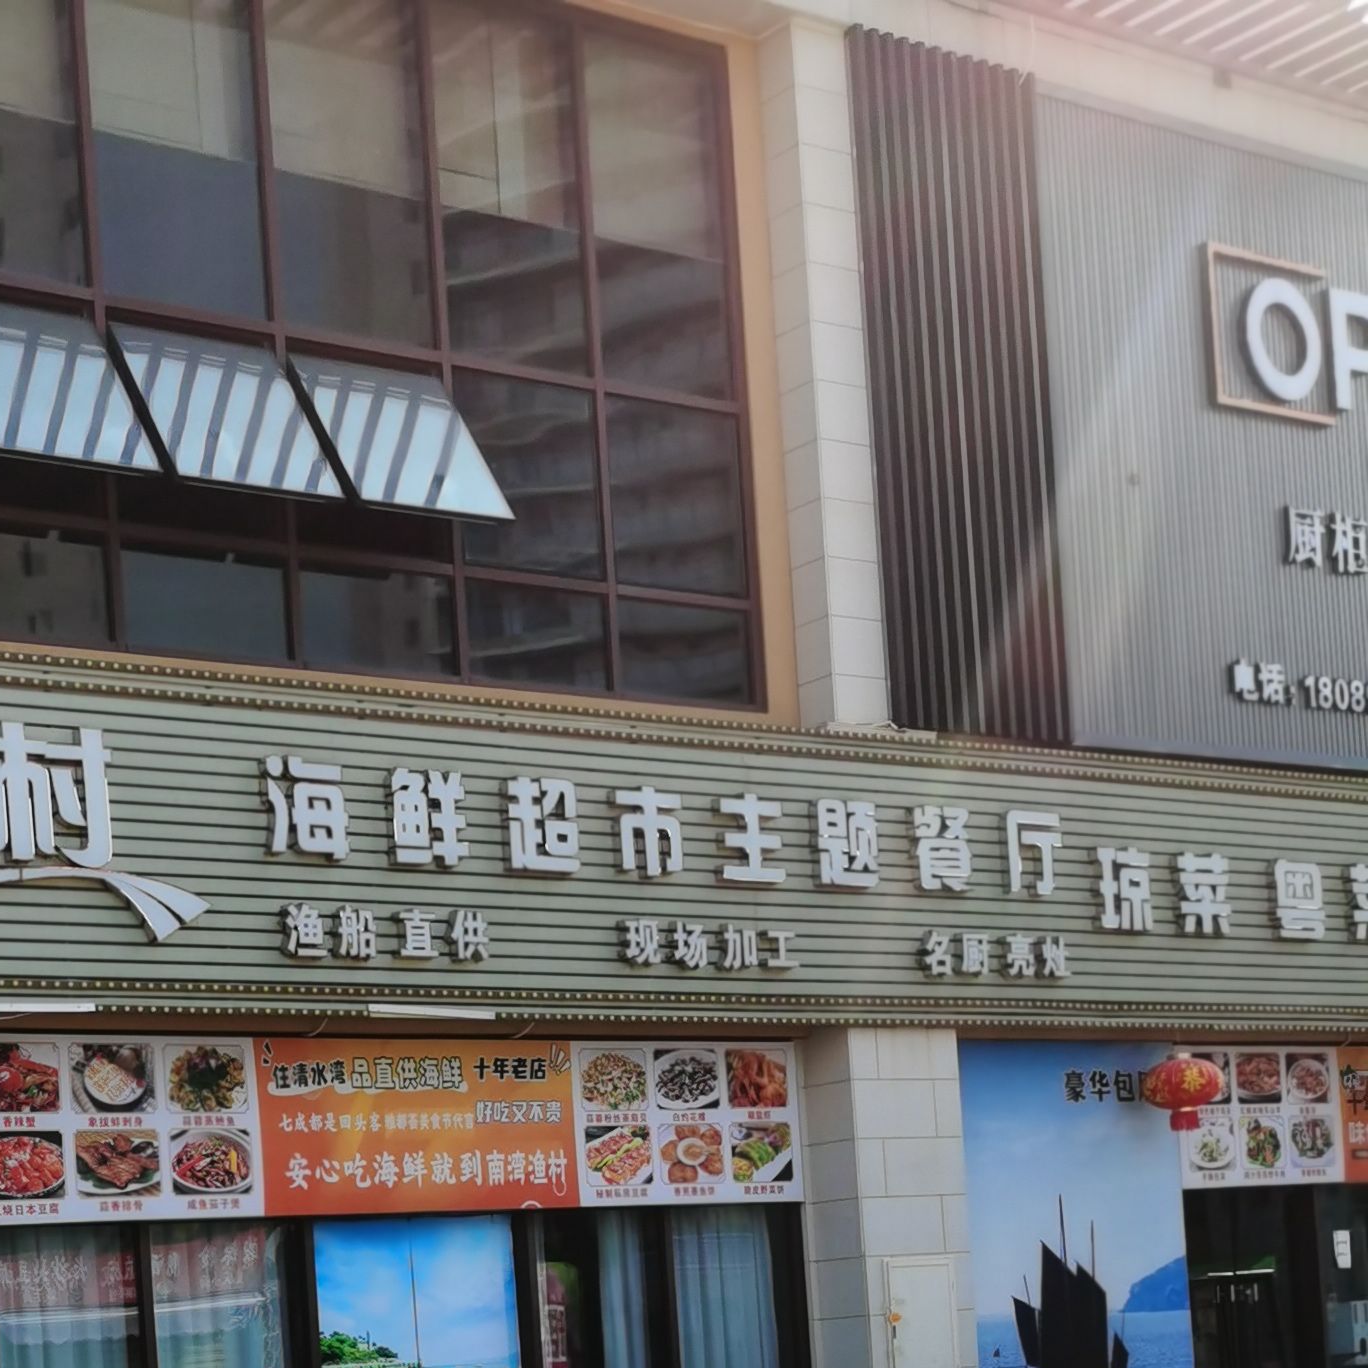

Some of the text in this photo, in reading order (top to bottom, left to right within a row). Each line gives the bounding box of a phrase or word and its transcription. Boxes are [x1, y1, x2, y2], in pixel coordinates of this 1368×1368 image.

[262, 755, 1063, 896] 海鲜超市主题餐厅
[281, 902, 1070, 979] 渔船直供 现场加工 名厨亮灶
[473, 1057, 547, 1080] 十年老店
[1064, 1070, 1148, 1102] 豪华包
[278, 1112, 382, 1133] 七成都是回头客
[475, 1100, 563, 1124] 好吃又不贵
[285, 1149, 568, 1192] 安心吃海鲜就到南湾渔村
